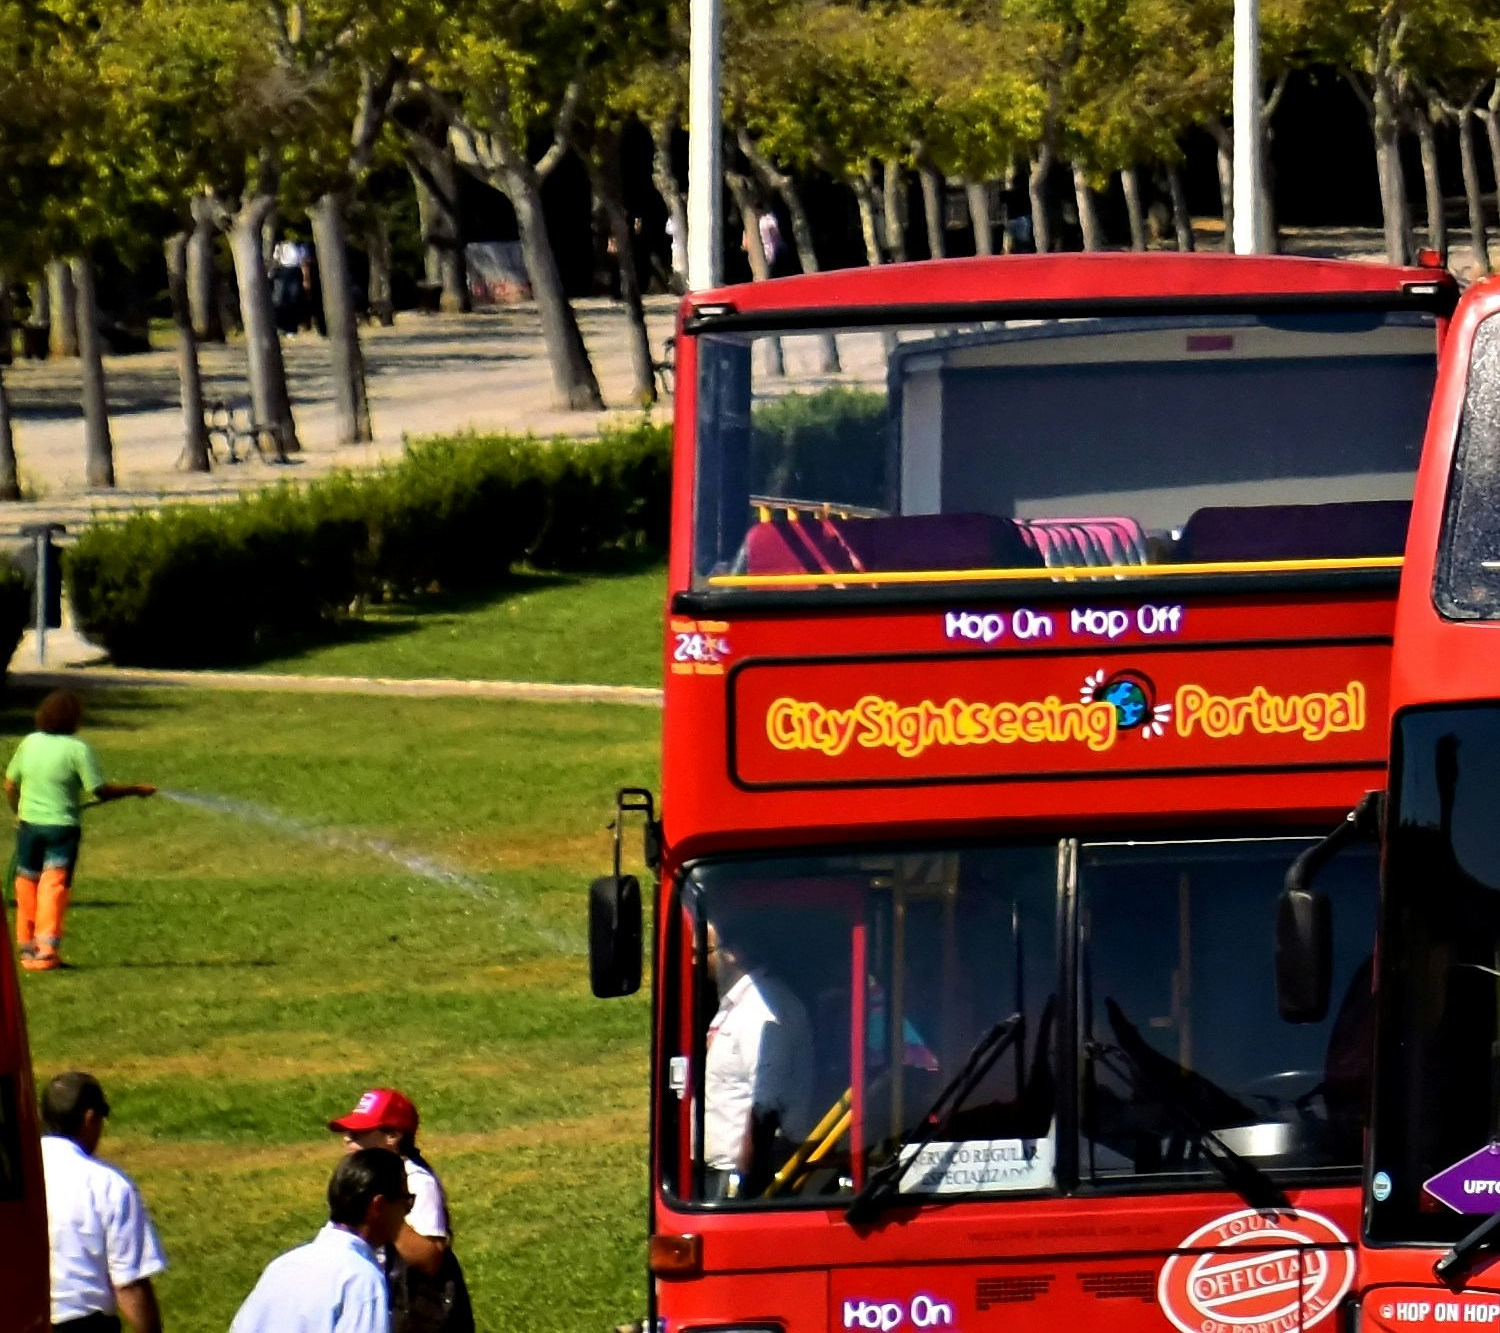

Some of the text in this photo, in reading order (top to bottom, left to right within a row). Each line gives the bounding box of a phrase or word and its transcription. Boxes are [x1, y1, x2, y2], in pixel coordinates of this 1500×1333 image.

[944, 604, 1182, 642] Hop On Hop Off
[1175, 681, 1367, 741] Portugal
[1193, 1252, 1321, 1300] OFFICIAL
[843, 1295, 953, 1332] Hop On
[1396, 1302, 1431, 1322] HOP
[1434, 1303, 1460, 1322] ON
[1463, 1304, 1500, 1323] HOP
